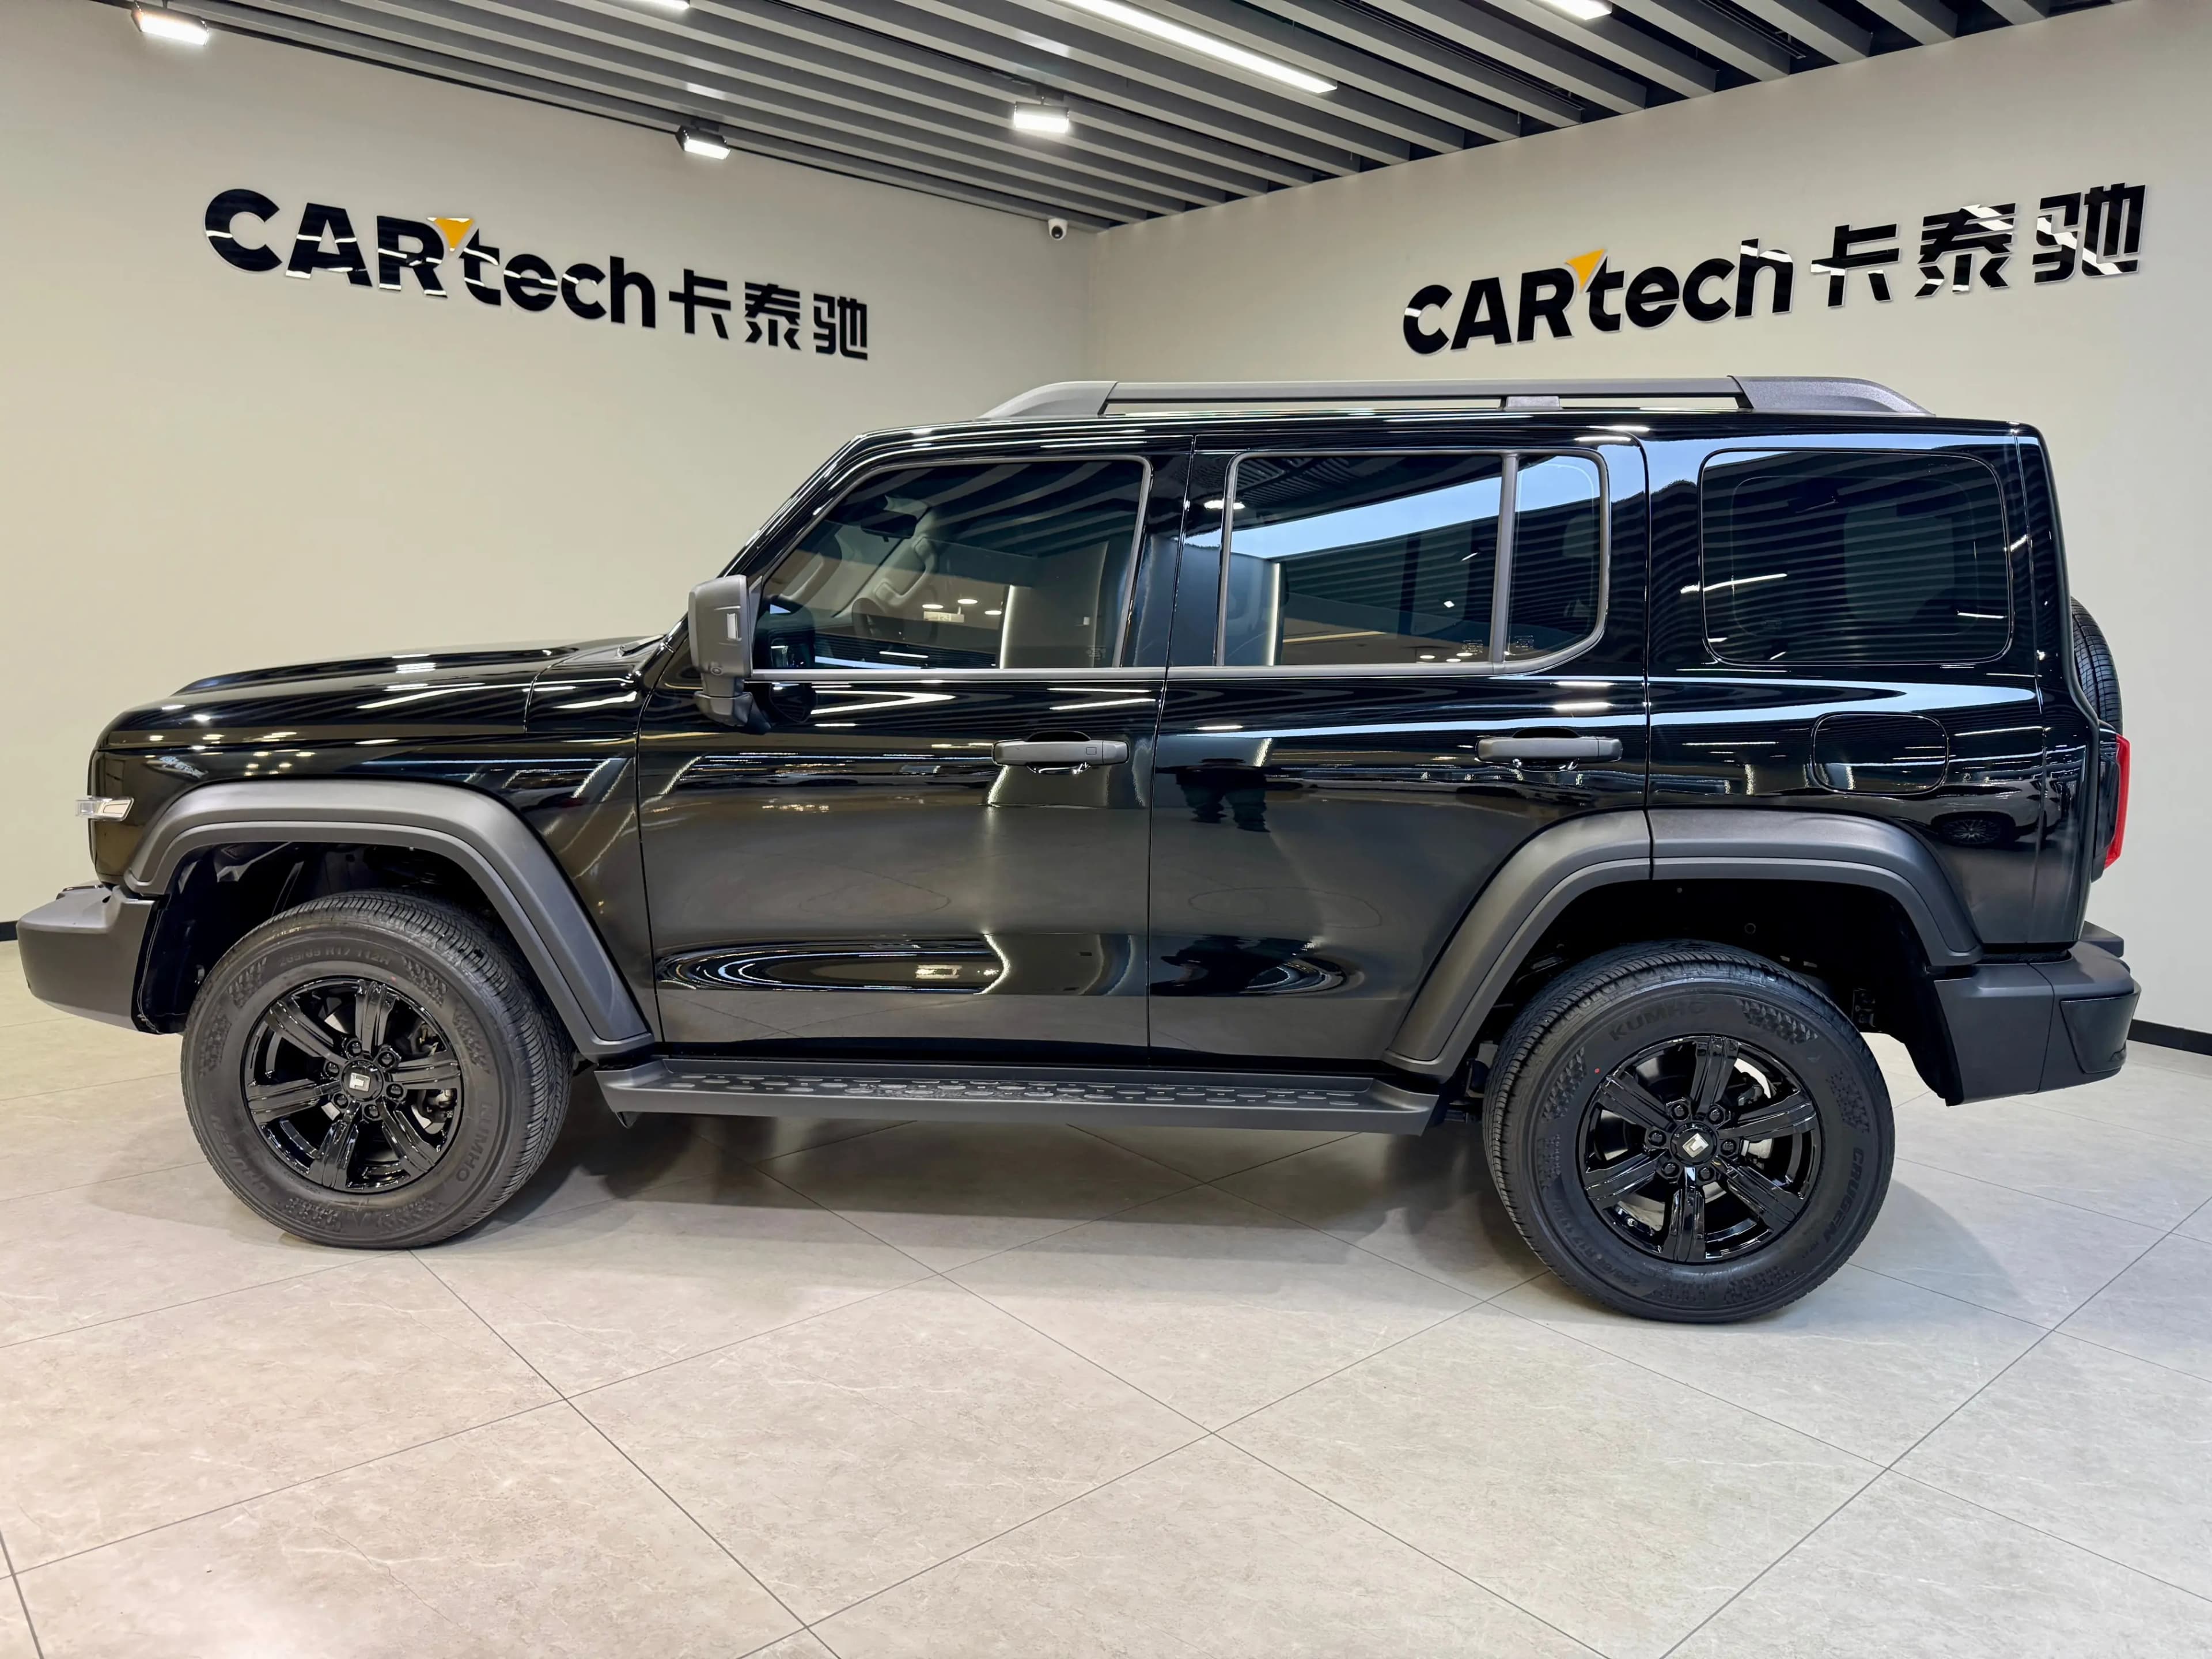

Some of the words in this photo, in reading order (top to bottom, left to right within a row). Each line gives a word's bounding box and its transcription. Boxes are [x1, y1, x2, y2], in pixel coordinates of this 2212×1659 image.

[204, 188, 657, 329] CARtech
[668, 269, 869, 361] 卡泰驰
[1403, 238, 1794, 355] CARtech
[1811, 182, 2147, 307] 卡泰驰
[1609, 999, 1707, 1041] KUMHO
[456, 1101, 494, 1182] KUMHO
[1823, 1146, 1865, 1243] CRUGEN
